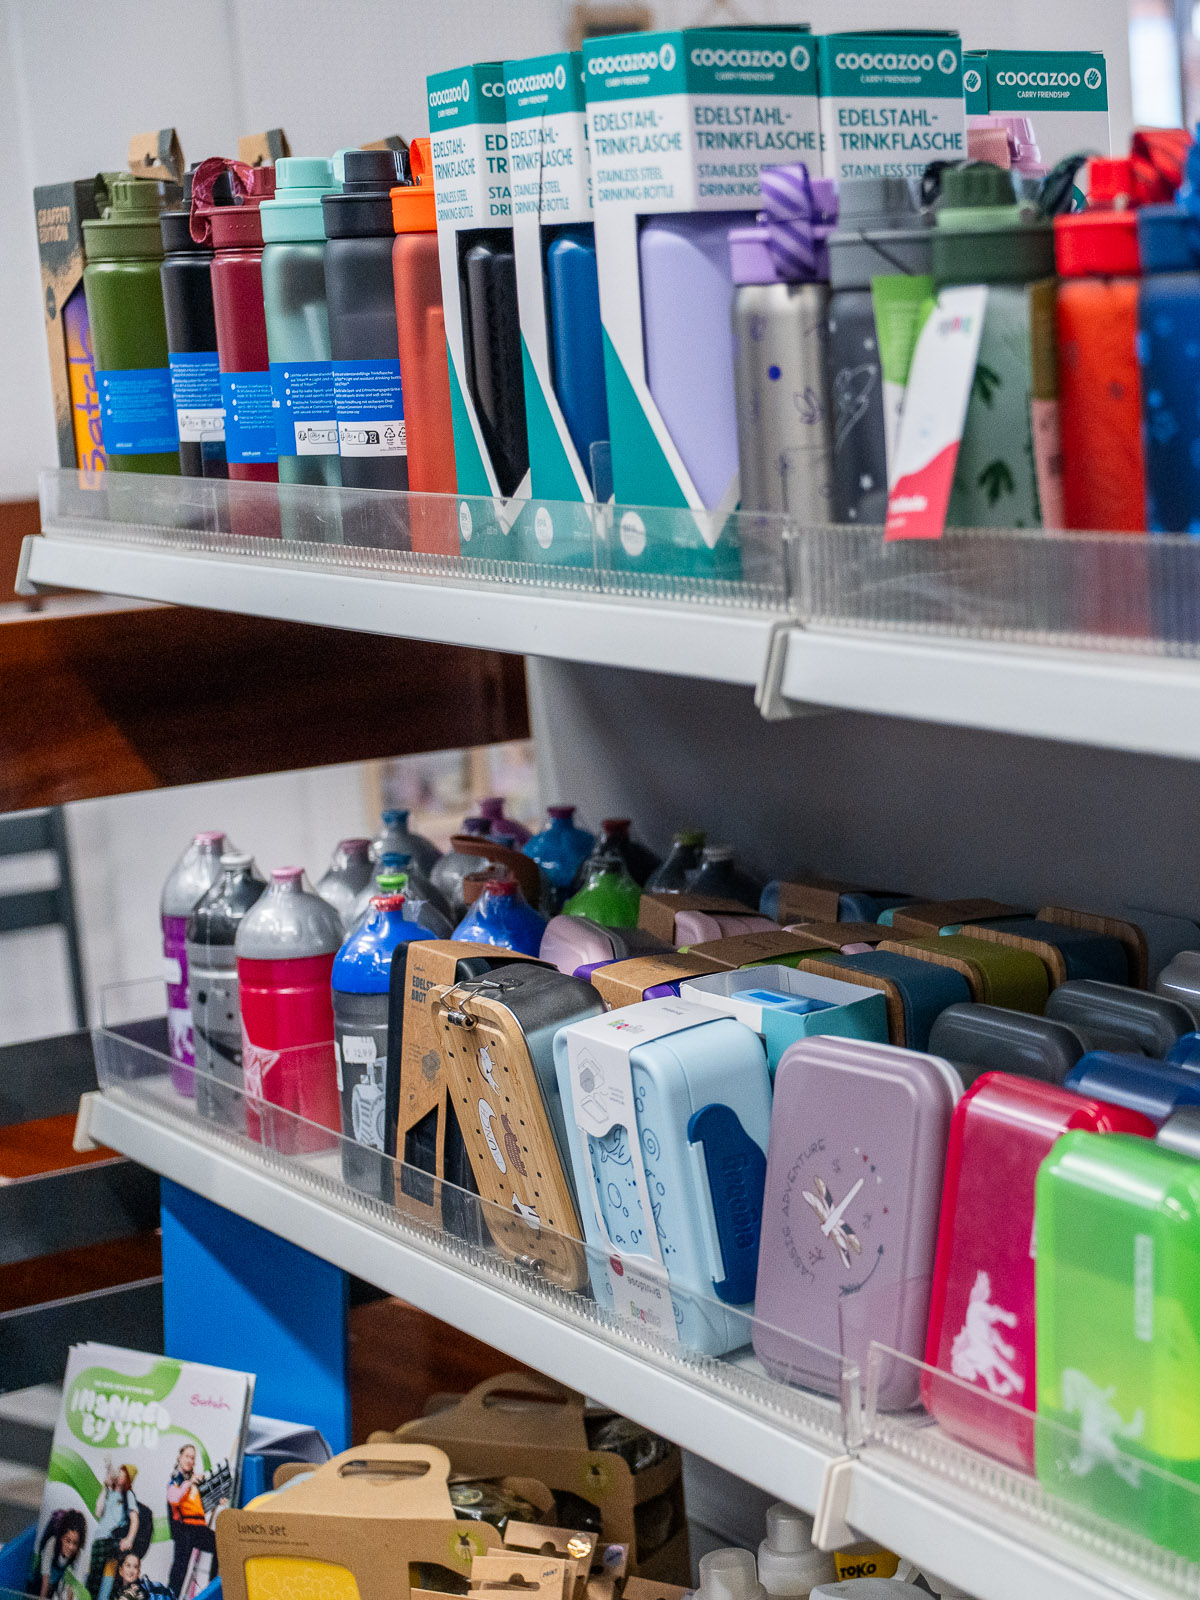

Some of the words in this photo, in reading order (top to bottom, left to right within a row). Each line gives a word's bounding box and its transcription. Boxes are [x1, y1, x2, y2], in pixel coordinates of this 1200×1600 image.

[588, 51, 659, 75] coocazoo
[691, 48, 787, 68] coocazoo
[835, 52, 934, 71] coocazoo
[506, 71, 555, 95] coocazoo
[996, 71, 1081, 87] coocazoo
[429, 84, 462, 107] coocazoo
[593, 110, 664, 133] EDELSTAHL-
[694, 106, 792, 126] EDELSTAHL-
[838, 108, 938, 128] EDELSTAHL-
[433, 137, 466, 159] EDELSTAHL-
[510, 127, 559, 149] EDELSTAHL-
[595, 132, 683, 156] TRINKFLASCHE
[695, 131, 816, 151] TRINKFLASCHE
[840, 131, 963, 151] TRINKFLASCHE
[434, 158, 476, 181] TRINKFLASCHE
[512, 148, 573, 172] TRINKFLASCHE
[597, 167, 641, 184] STAINLESS
[698, 163, 757, 178] STAINLESS
[841, 163, 904, 178] STAINLESS
[598, 187, 642, 202] DRINKING
[643, 184, 674, 200] BOTTLE
[700, 183, 761, 198] DRINKING
[412, 975, 437, 992] EDELST
